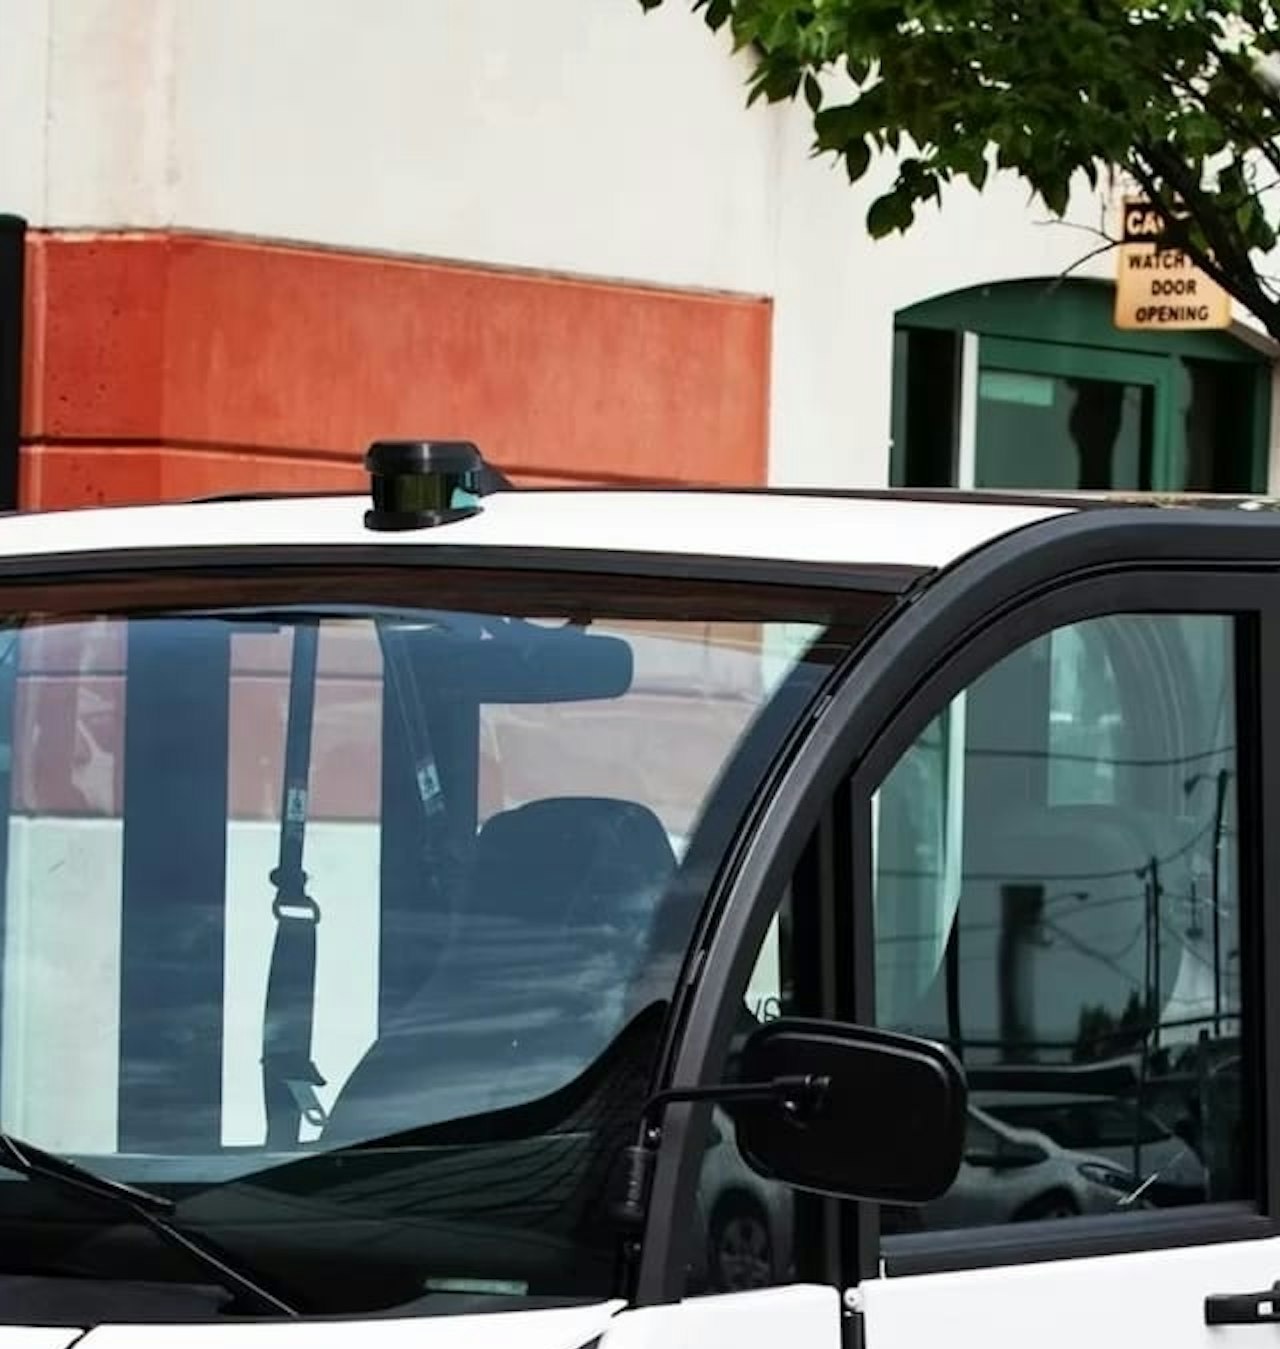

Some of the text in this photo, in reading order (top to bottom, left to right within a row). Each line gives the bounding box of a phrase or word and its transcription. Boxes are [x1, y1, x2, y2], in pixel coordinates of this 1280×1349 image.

[1129, 253, 1185, 270] WATCH
[1152, 280, 1197, 296] DOOR
[1136, 306, 1209, 322] OPENING
